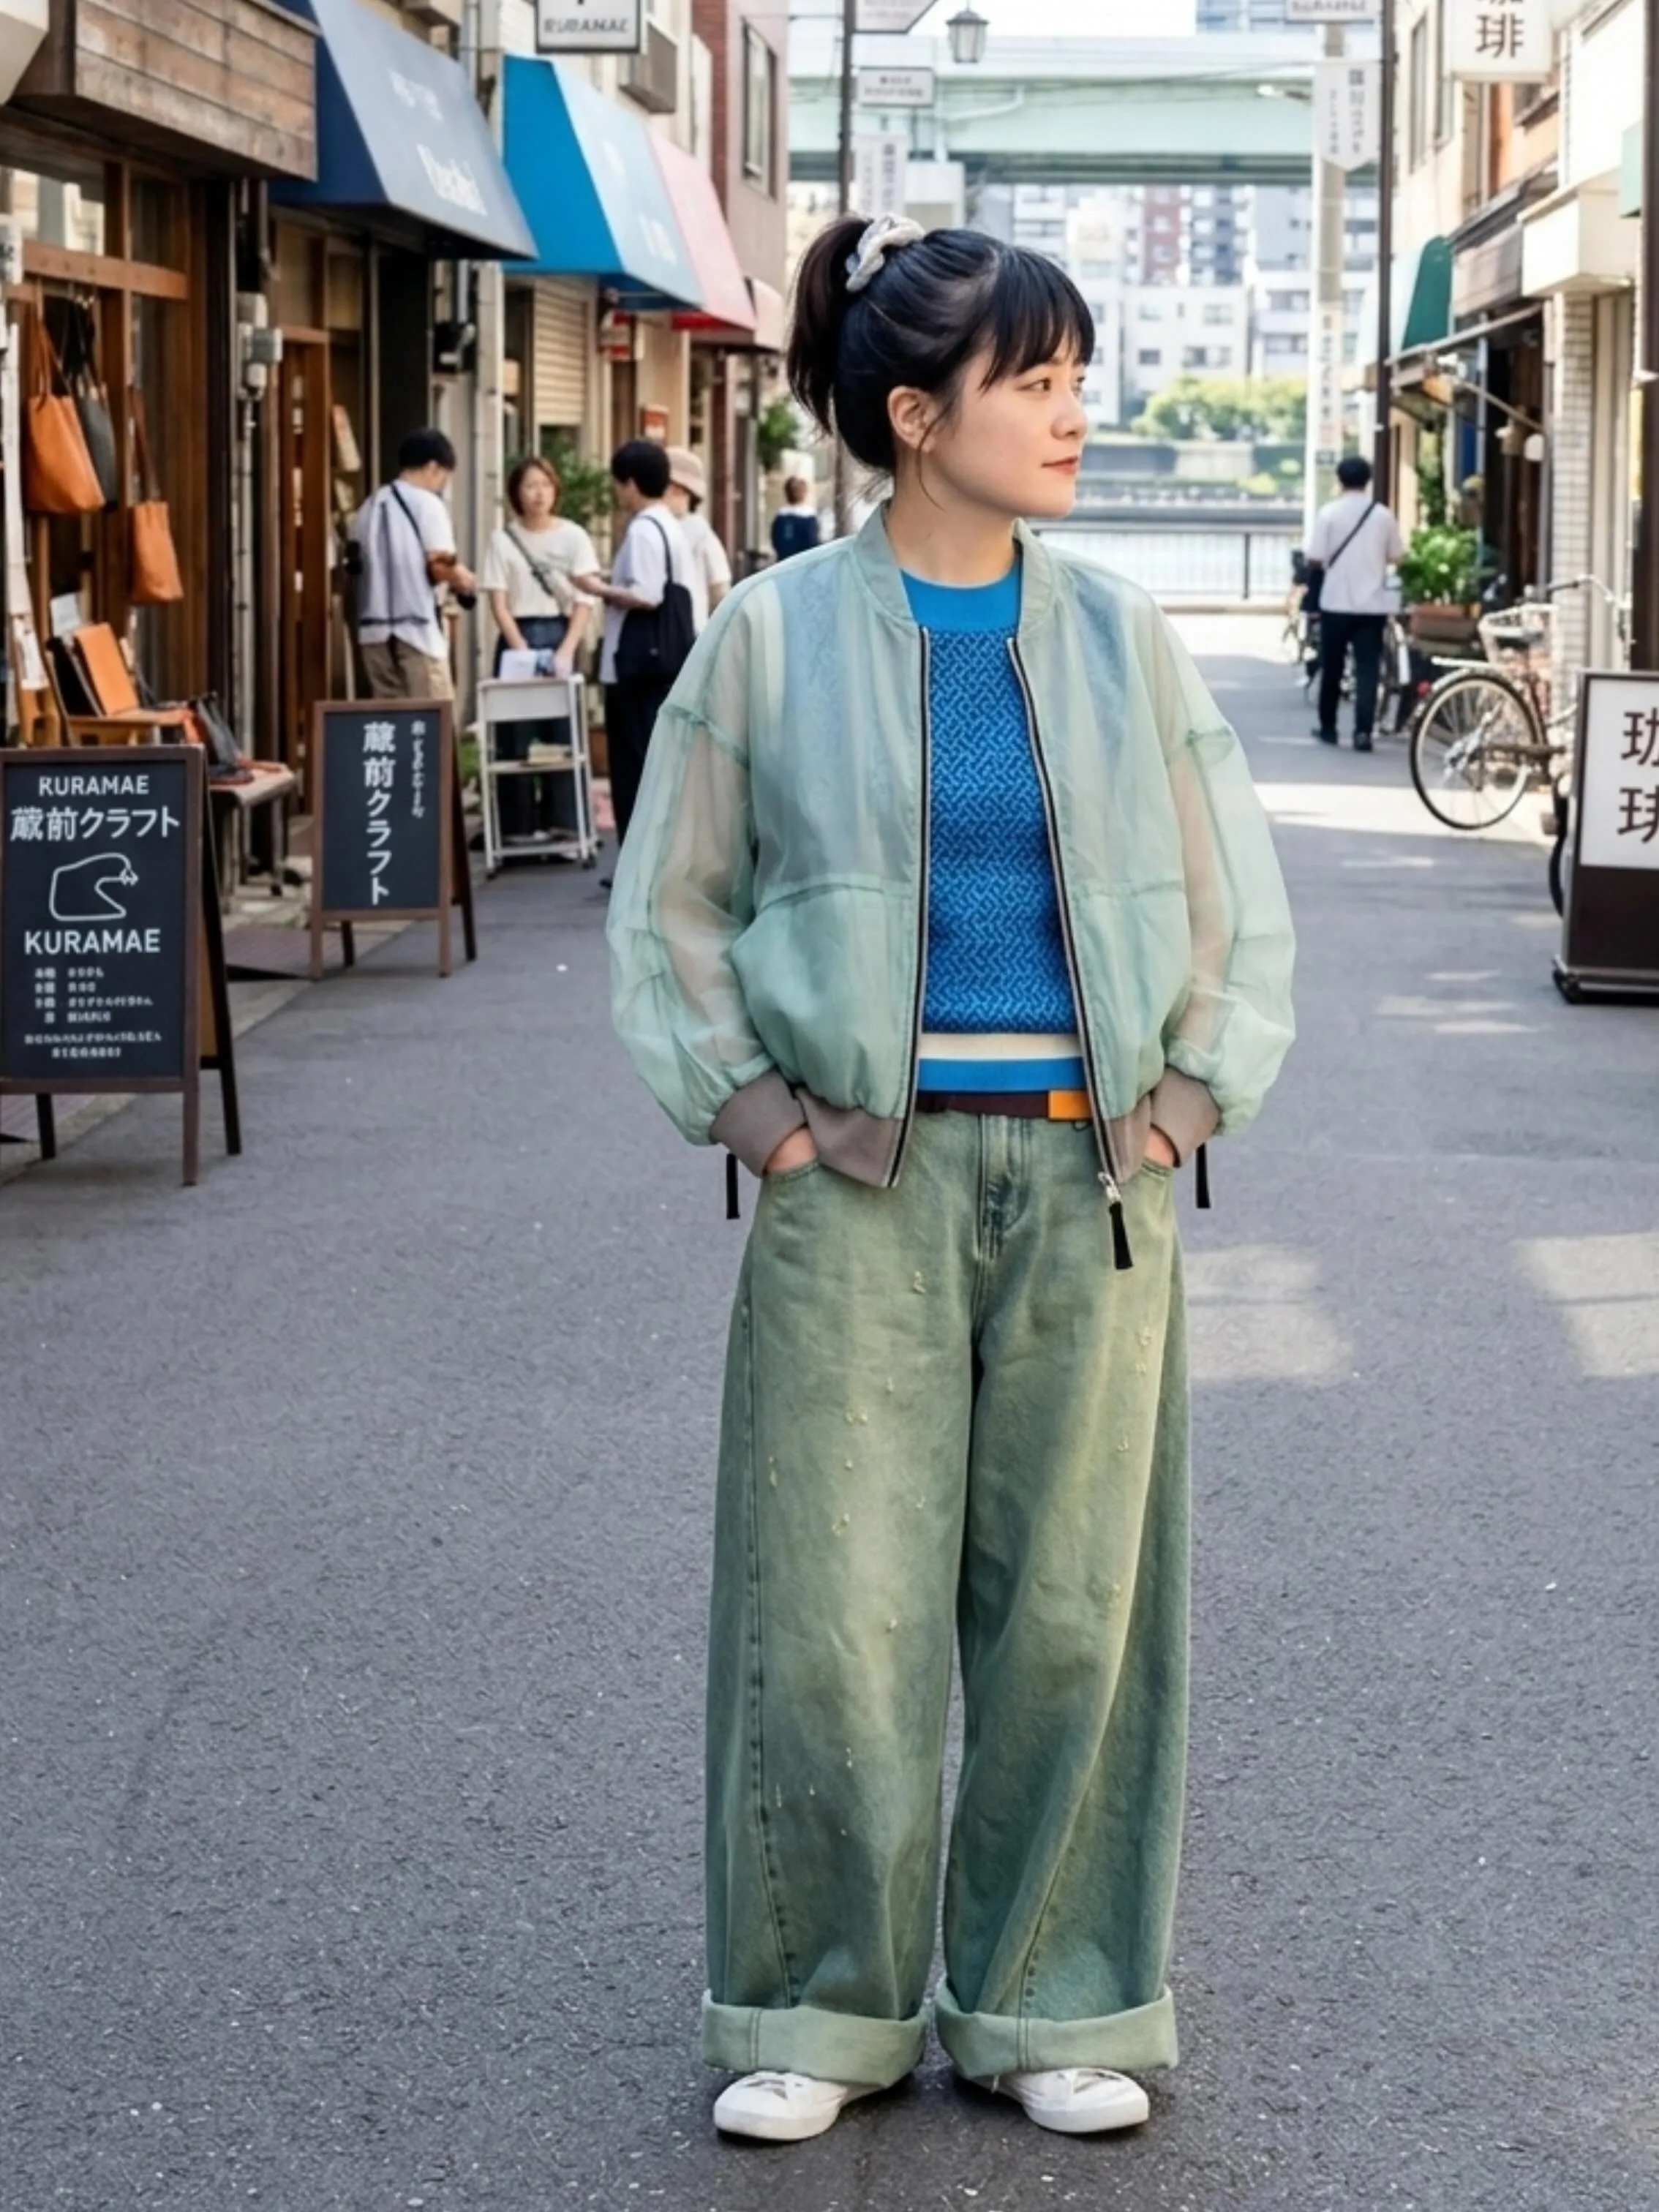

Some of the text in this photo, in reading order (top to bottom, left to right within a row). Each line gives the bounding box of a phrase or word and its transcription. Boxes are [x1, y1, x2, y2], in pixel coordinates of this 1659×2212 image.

[1475, 0, 1524, 59] 琲
[10, 806, 181, 840] 蔵前クラフト
[363, 721, 396, 905] 蔵前クラフト
[24, 928, 161, 955] KURAMAE
